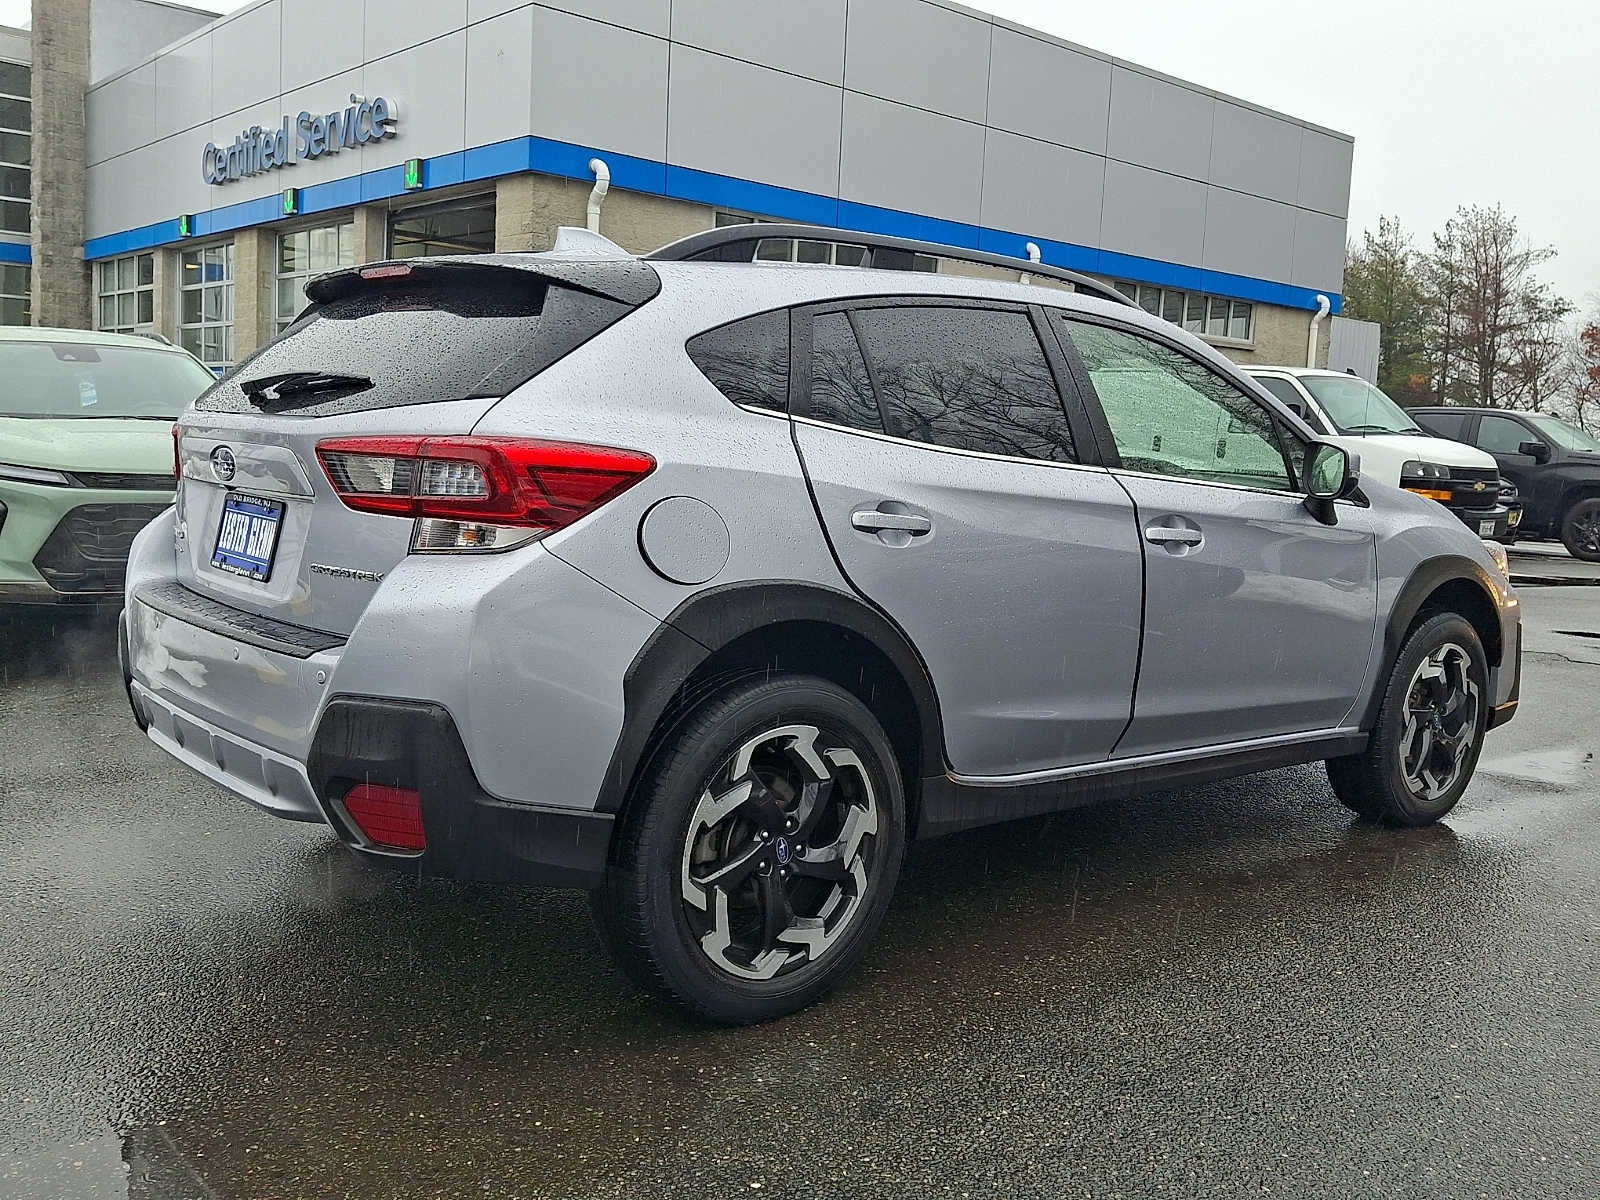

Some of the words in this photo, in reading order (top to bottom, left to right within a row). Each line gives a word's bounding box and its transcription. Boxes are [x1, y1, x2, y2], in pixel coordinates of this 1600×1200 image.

[202, 115, 290, 184] Certified
[296, 93, 392, 160] Service
[218, 511, 249, 553] LESTER
[247, 517, 277, 560] GLENN
[309, 563, 384, 583] CROSSTREK
